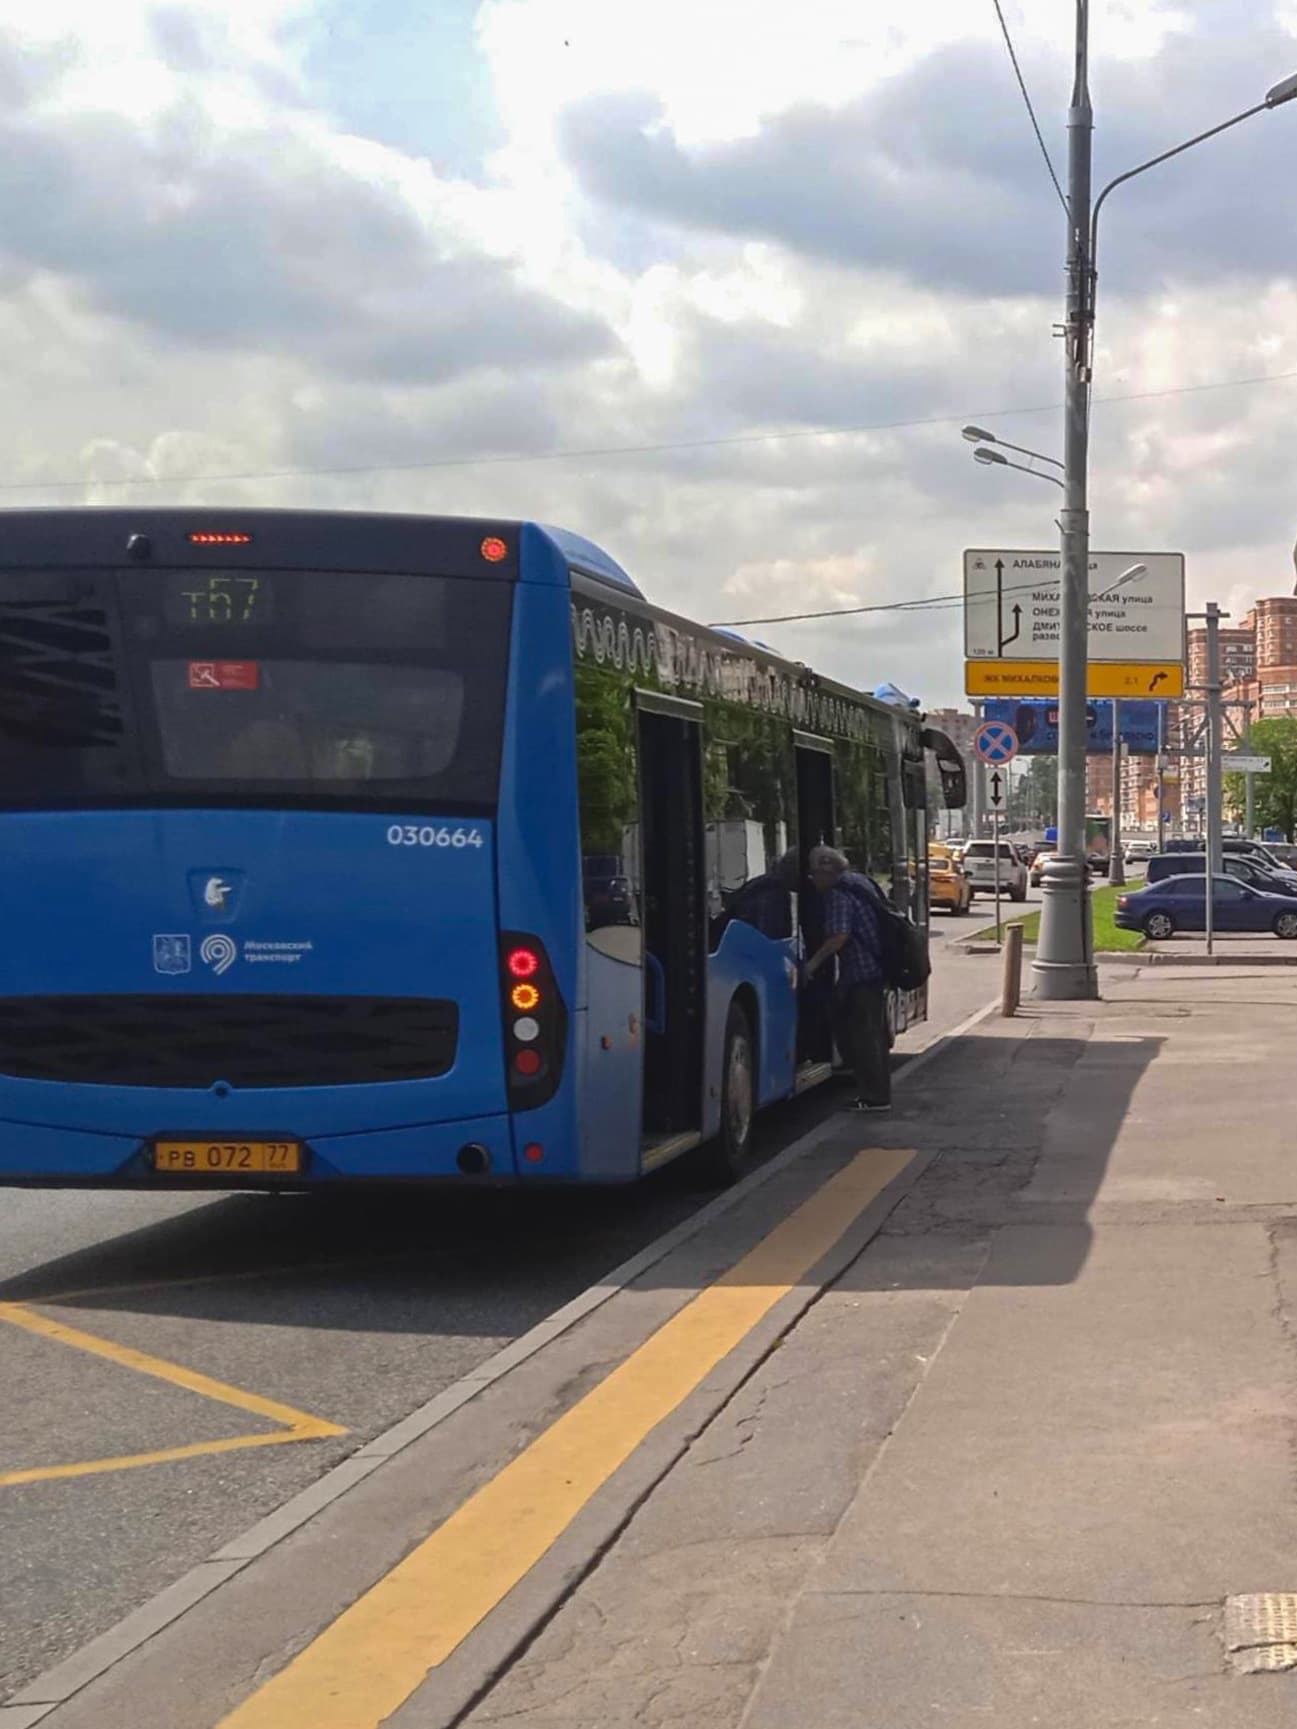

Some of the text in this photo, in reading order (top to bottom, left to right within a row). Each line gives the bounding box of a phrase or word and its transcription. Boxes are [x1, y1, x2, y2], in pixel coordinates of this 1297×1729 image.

[1122, 596, 1153, 605] улица
[1095, 609, 1126, 619] улица
[1116, 625, 1147, 633] шоссе
[387, 824, 484, 849] 030664
[206, 1146, 252, 1168] 072
[267, 1145, 289, 1162] 77
